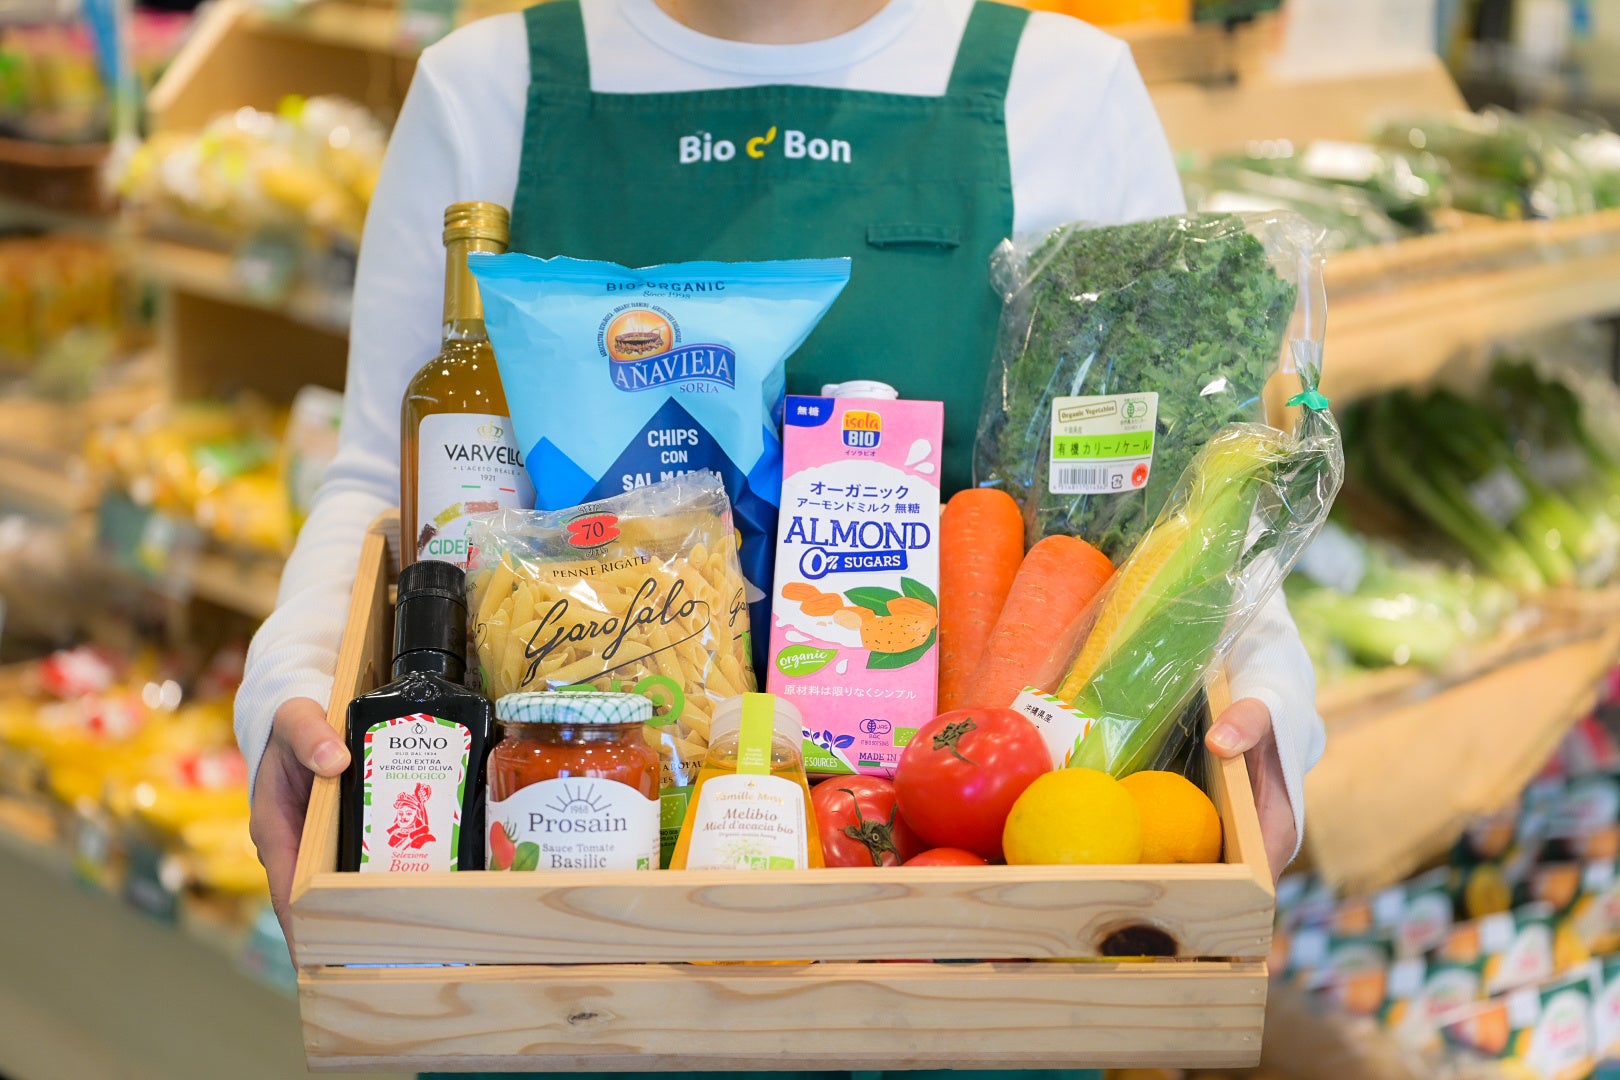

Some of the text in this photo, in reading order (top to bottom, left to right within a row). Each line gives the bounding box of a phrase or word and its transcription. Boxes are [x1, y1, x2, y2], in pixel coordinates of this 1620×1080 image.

[679, 132, 736, 164] Bio
[784, 129, 852, 164] Bon
[614, 349, 734, 390] AÑAVIEJA
[679, 382, 719, 393] SORIA
[797, 405, 820, 417] 無糖
[844, 413, 879, 430] isola
[647, 428, 699, 447] CHIPS
[848, 430, 875, 447] BIO
[660, 450, 688, 464] CON
[480, 474, 497, 482] 1921
[494, 467, 516, 476] REALE
[810, 481, 910, 500] オーガニック
[796, 497, 921, 514] アーモンドミルク 無糖
[581, 521, 605, 540] 70
[783, 516, 932, 550] ALMOND
[552, 556, 648, 578] PENNE RIGATE
[844, 555, 902, 568] SUGARS
[521, 577, 710, 687] Garofalo
[779, 650, 828, 668] organic
[783, 684, 917, 700] 原材料は限りなくシンプル
[389, 736, 448, 750] BONO
[809, 757, 838, 768] SOURCES
[858, 752, 897, 761] MADE IN
[385, 772, 447, 780] BIOLOGICO
[722, 807, 778, 822] Melibio
[528, 812, 628, 834] Prosain
[702, 820, 794, 835] Miel d'acacia bio
[391, 851, 429, 860] Selezione
[542, 843, 615, 853] Sauce Tomate
[389, 859, 431, 873] Bono
[550, 854, 607, 869] Basilic
